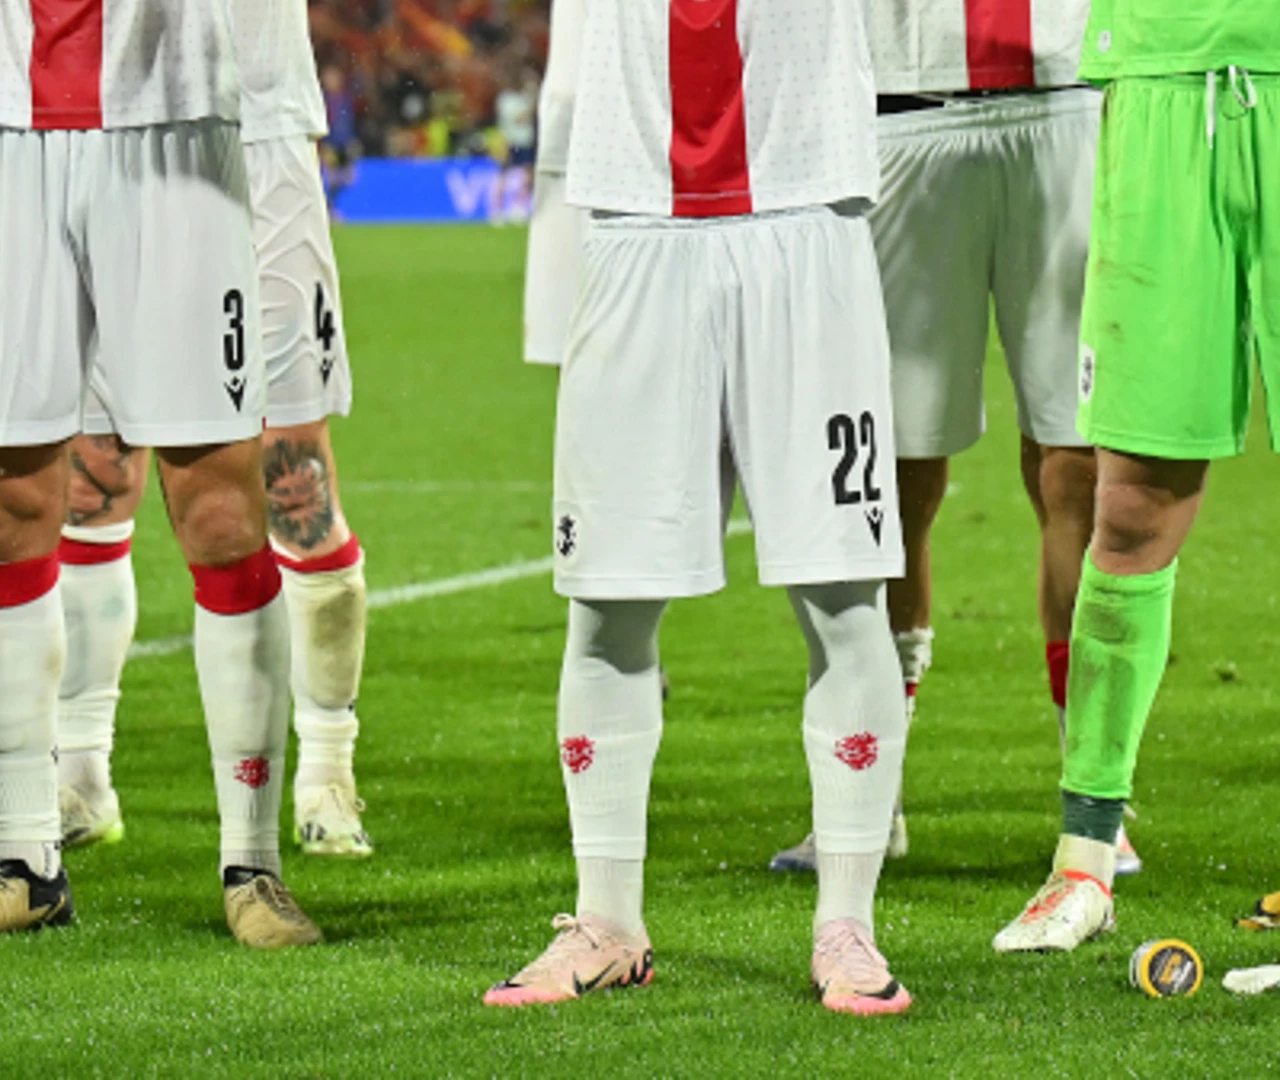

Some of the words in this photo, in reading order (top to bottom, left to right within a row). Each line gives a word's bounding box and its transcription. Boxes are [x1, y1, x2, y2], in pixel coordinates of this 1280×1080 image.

[223, 289, 244, 371] 3
[315, 282, 336, 351] 4
[827, 410, 882, 506] 22
